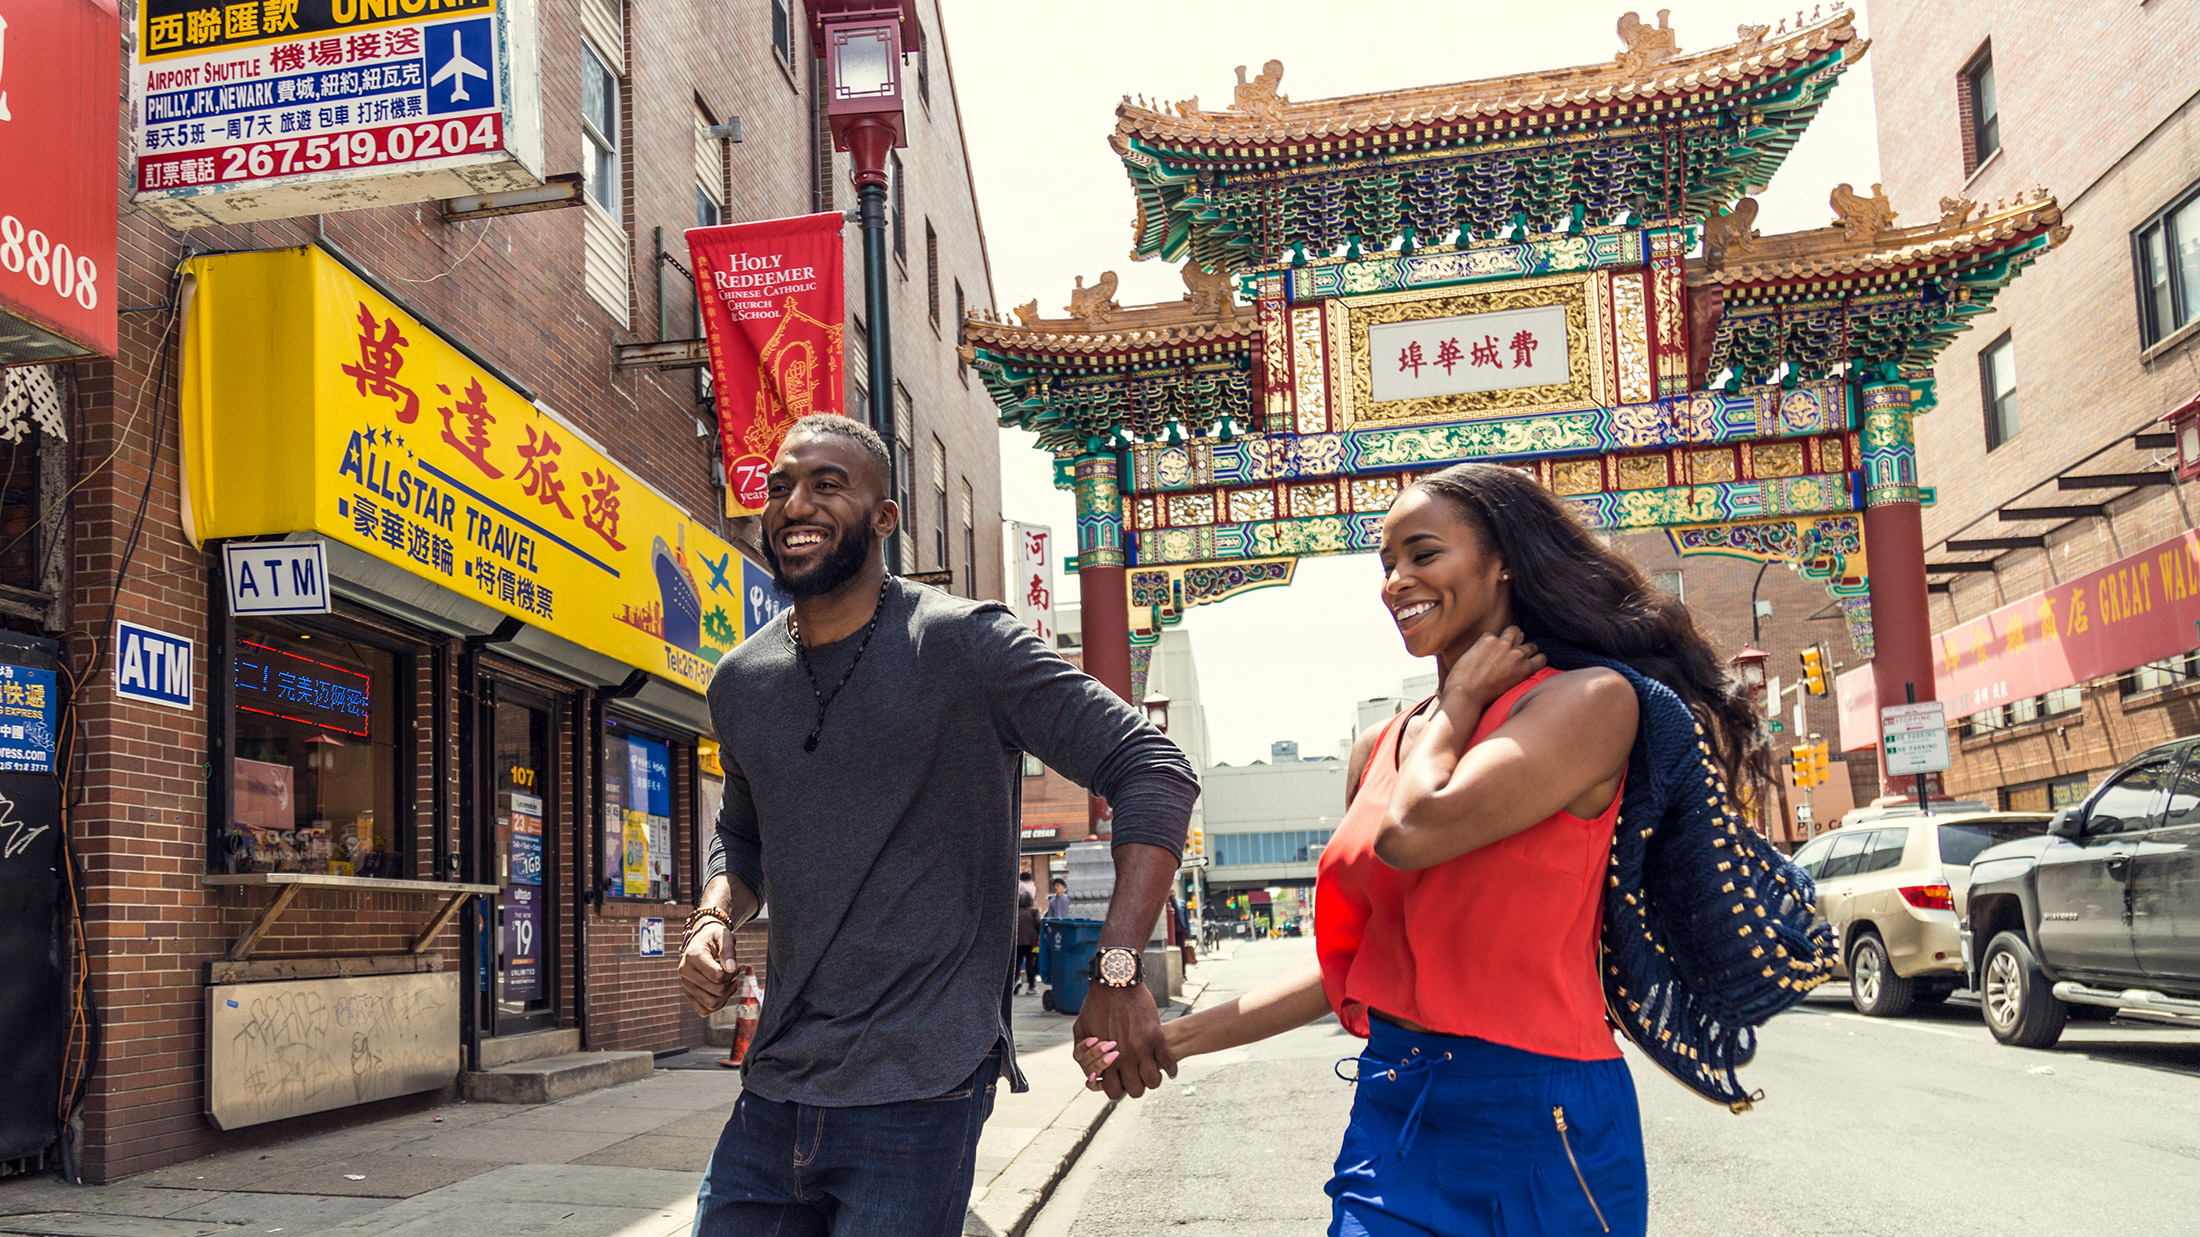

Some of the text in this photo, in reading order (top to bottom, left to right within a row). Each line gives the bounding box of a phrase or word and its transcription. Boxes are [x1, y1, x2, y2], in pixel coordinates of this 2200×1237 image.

[150, 0, 300, 50] 西聯匯款
[331, 0, 456, 24] UNI
[269, 27, 420, 73] 機場接送
[148, 82, 273, 121] PHILLY,JFK,NEWARK
[145, 123, 206, 150] 每天5班
[145, 116, 497, 188] 訂票電話 267.519.0204
[0, 215, 97, 310] 8808
[341, 300, 628, 552] 萬達旅遊
[737, 463, 768, 492] 75
[339, 430, 538, 574] ALLSTAR TRAVEL
[740, 490, 768, 504] years
[239, 558, 316, 598] ATM
[2099, 561, 2151, 626] GREAT
[2159, 538, 2200, 604] WAL
[121, 633, 188, 697] ATM
[0, 680, 45, 708] 快遞
[5, 706, 43, 718] EXPRESS
[1895, 715, 1931, 725] STOPPING
[1908, 731, 1936, 740] PARKING
[1909, 743, 1938, 751] PARKING
[0, 747, 46, 761] ress.com
[510, 766, 535, 786] 107
[1032, 828, 1056, 838] CREAM
[1798, 821, 1822, 832] Po
